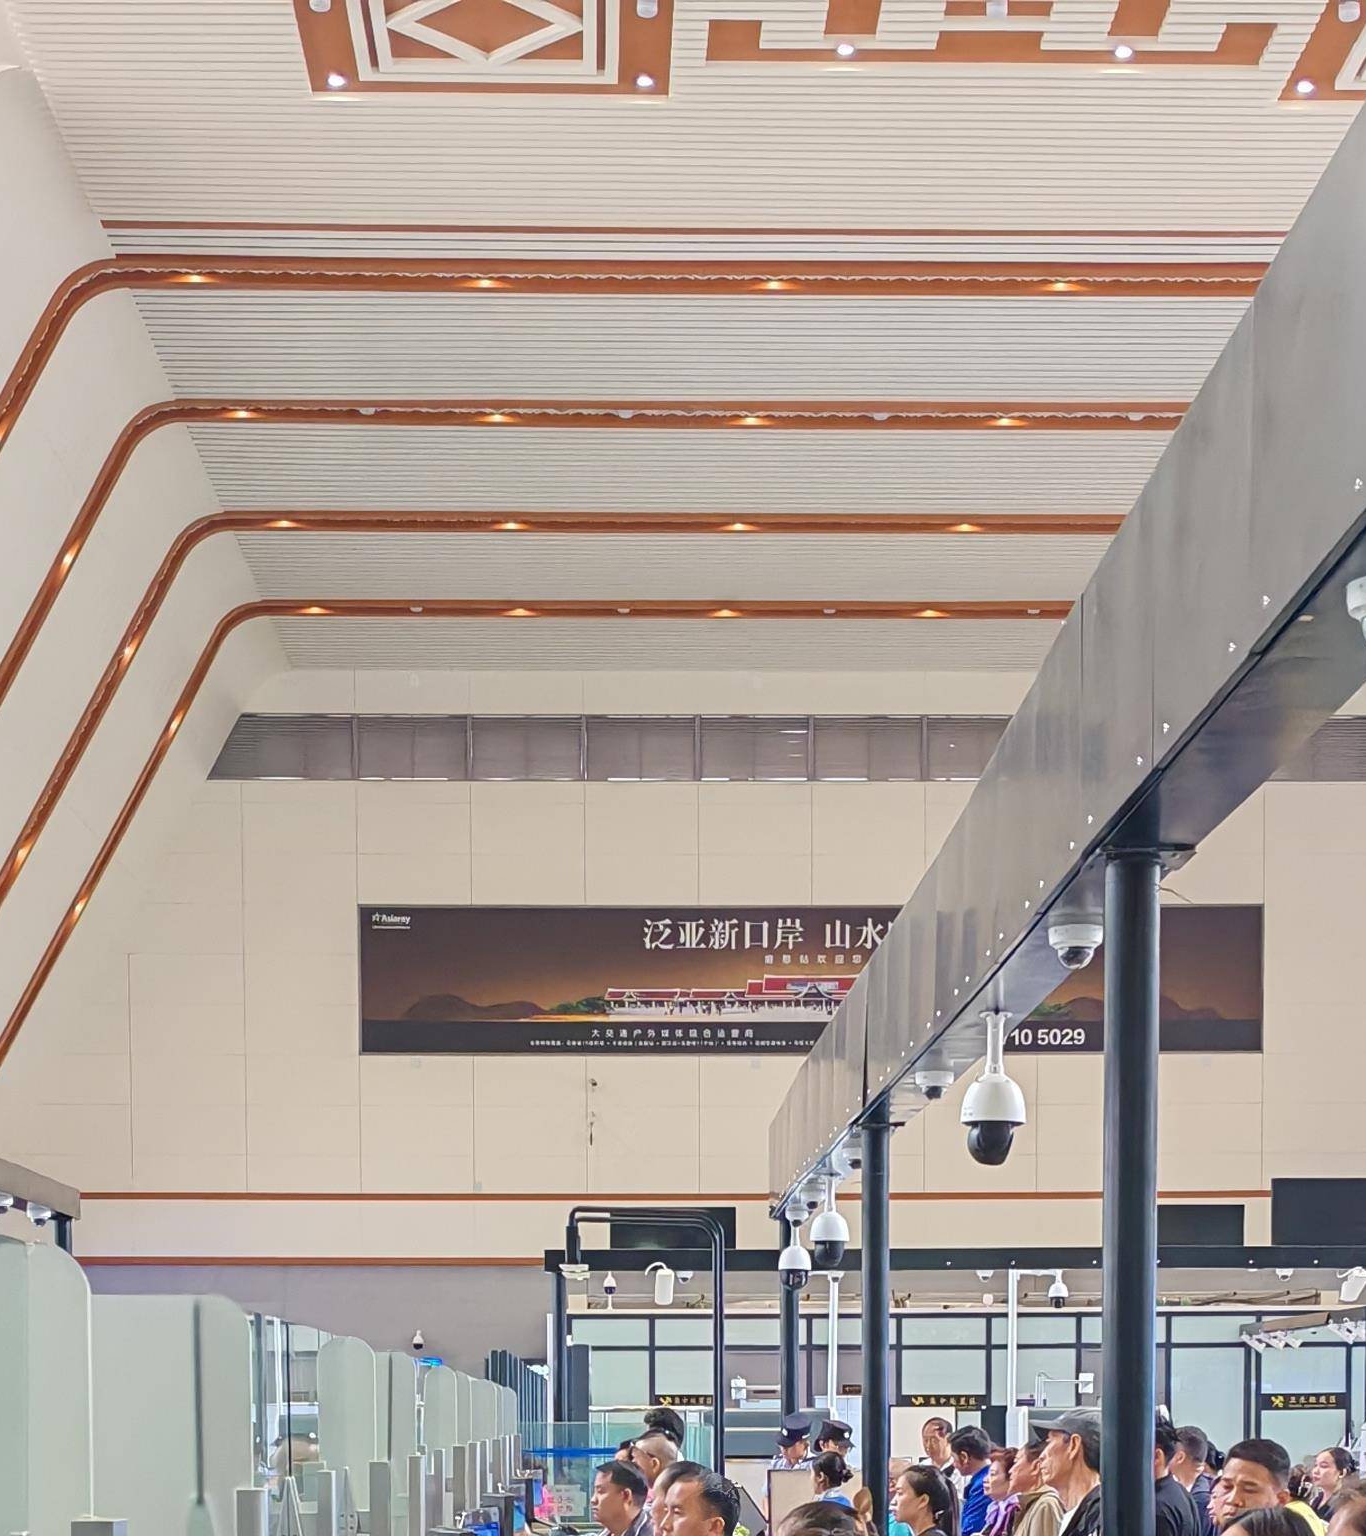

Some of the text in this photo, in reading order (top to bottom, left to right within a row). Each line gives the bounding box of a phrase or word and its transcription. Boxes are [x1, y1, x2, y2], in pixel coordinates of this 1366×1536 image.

[643, 918, 895, 950] 泛亚新口岸 山水
[1037, 1029, 1085, 1045] 5029
